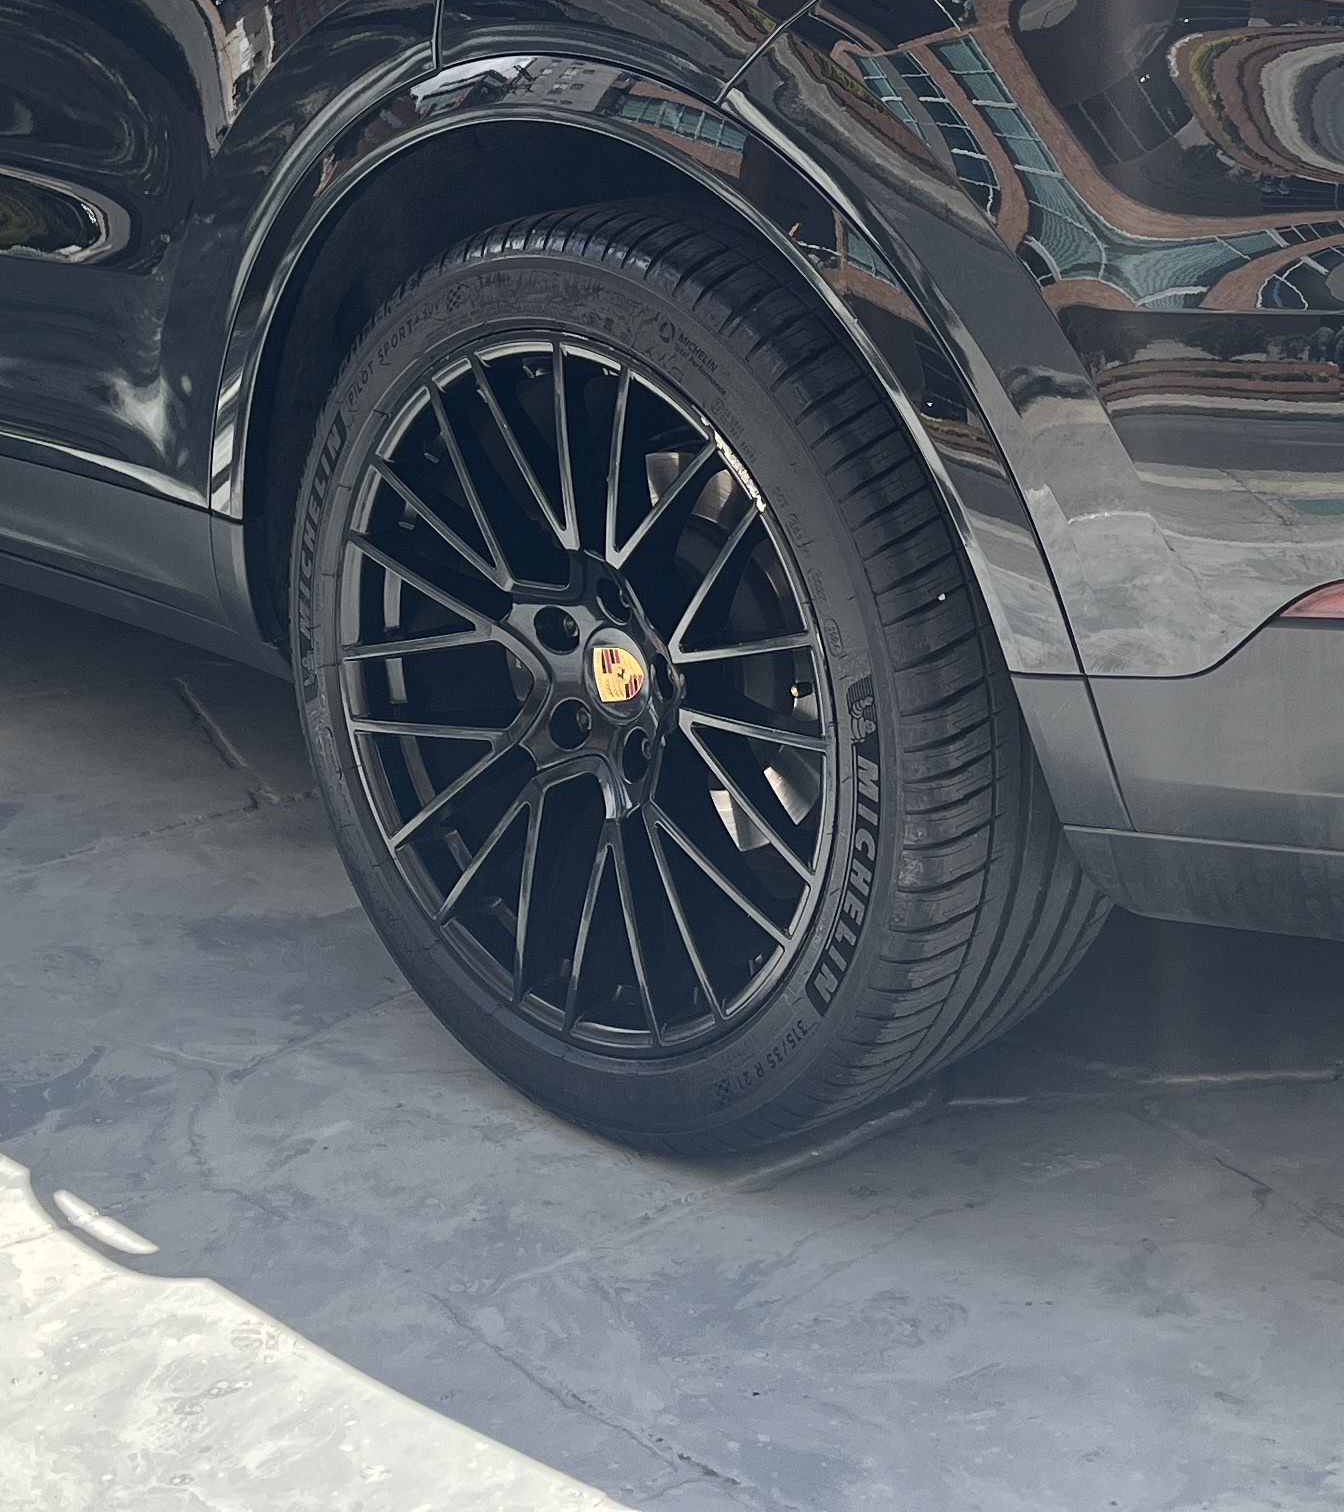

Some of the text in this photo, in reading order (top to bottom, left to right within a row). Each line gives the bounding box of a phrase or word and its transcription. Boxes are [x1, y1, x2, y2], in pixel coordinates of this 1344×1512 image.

[348, 360, 375, 407] PILOT
[378, 319, 414, 364] SPORT
[677, 332, 719, 374] MICHELIN
[298, 424, 342, 640] MICHELIN
[814, 755, 879, 1004] MICHELIN
